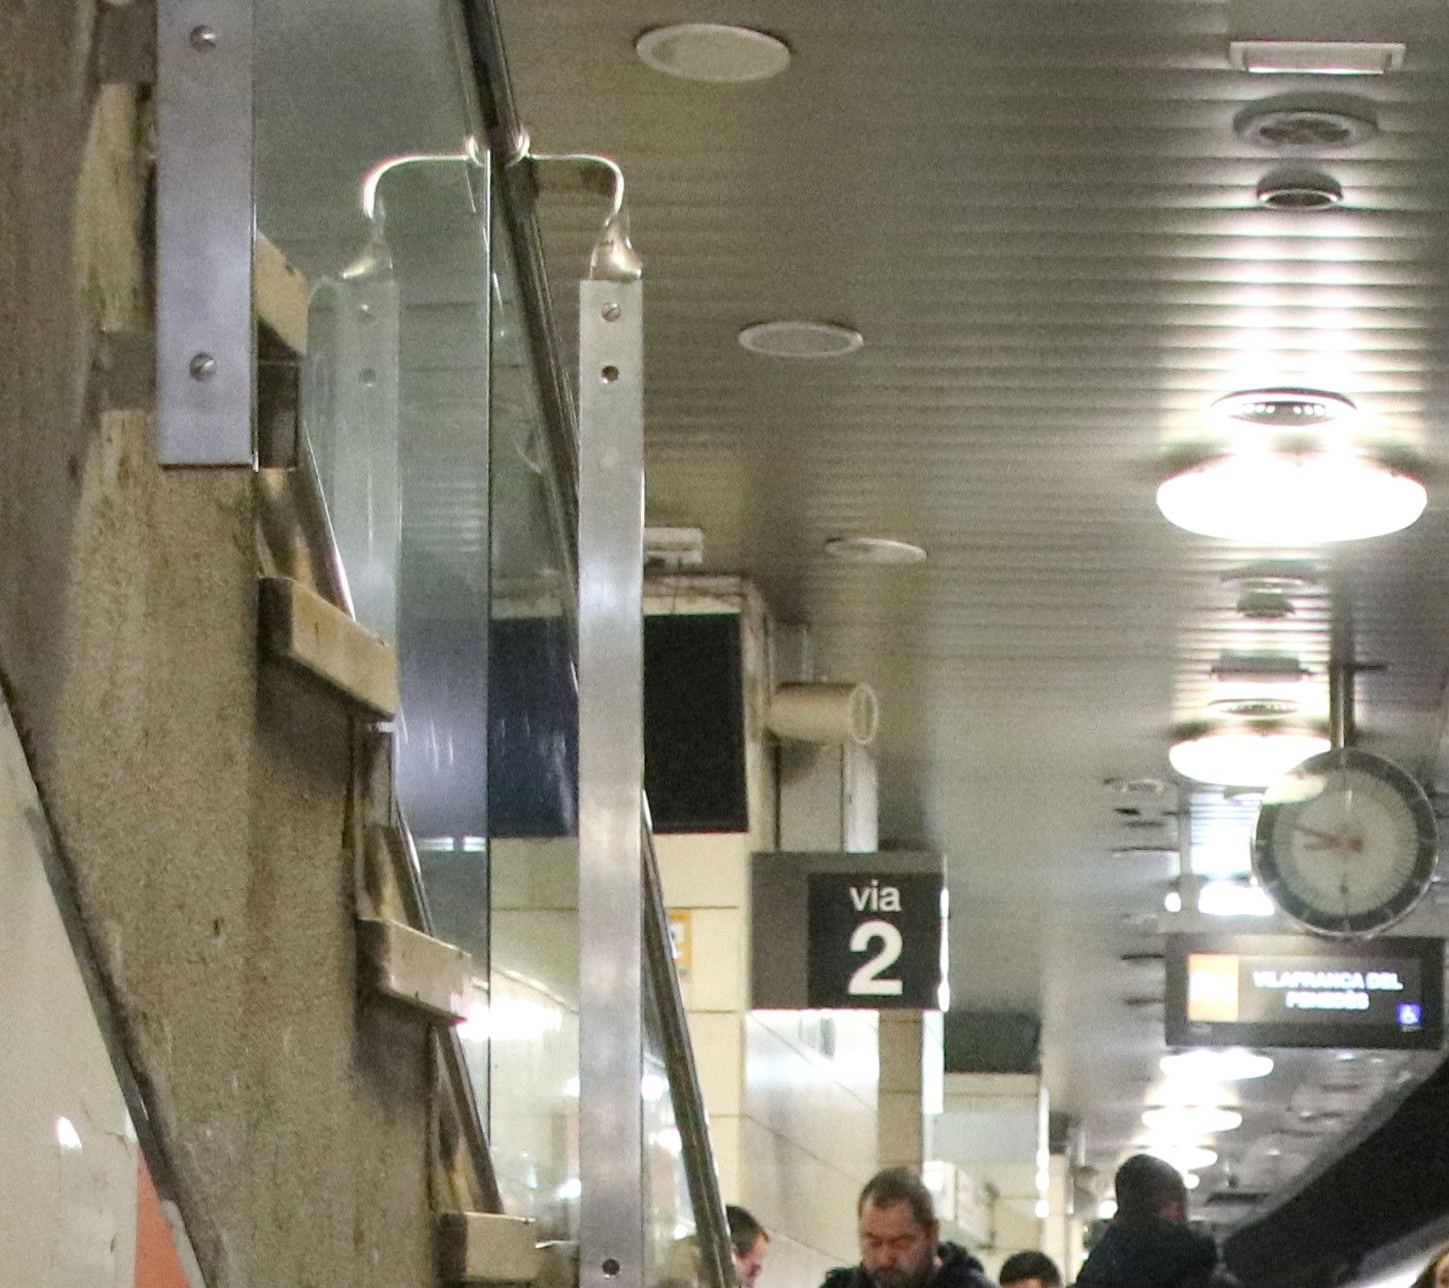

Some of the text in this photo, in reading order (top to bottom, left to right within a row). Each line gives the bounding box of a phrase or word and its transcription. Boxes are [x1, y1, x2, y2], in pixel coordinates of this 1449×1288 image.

[849, 879, 902, 912] via
[848, 919, 903, 995] 2
[1252, 970, 1365, 990] VILAFRANCA
[1366, 971, 1404, 991] DEL
